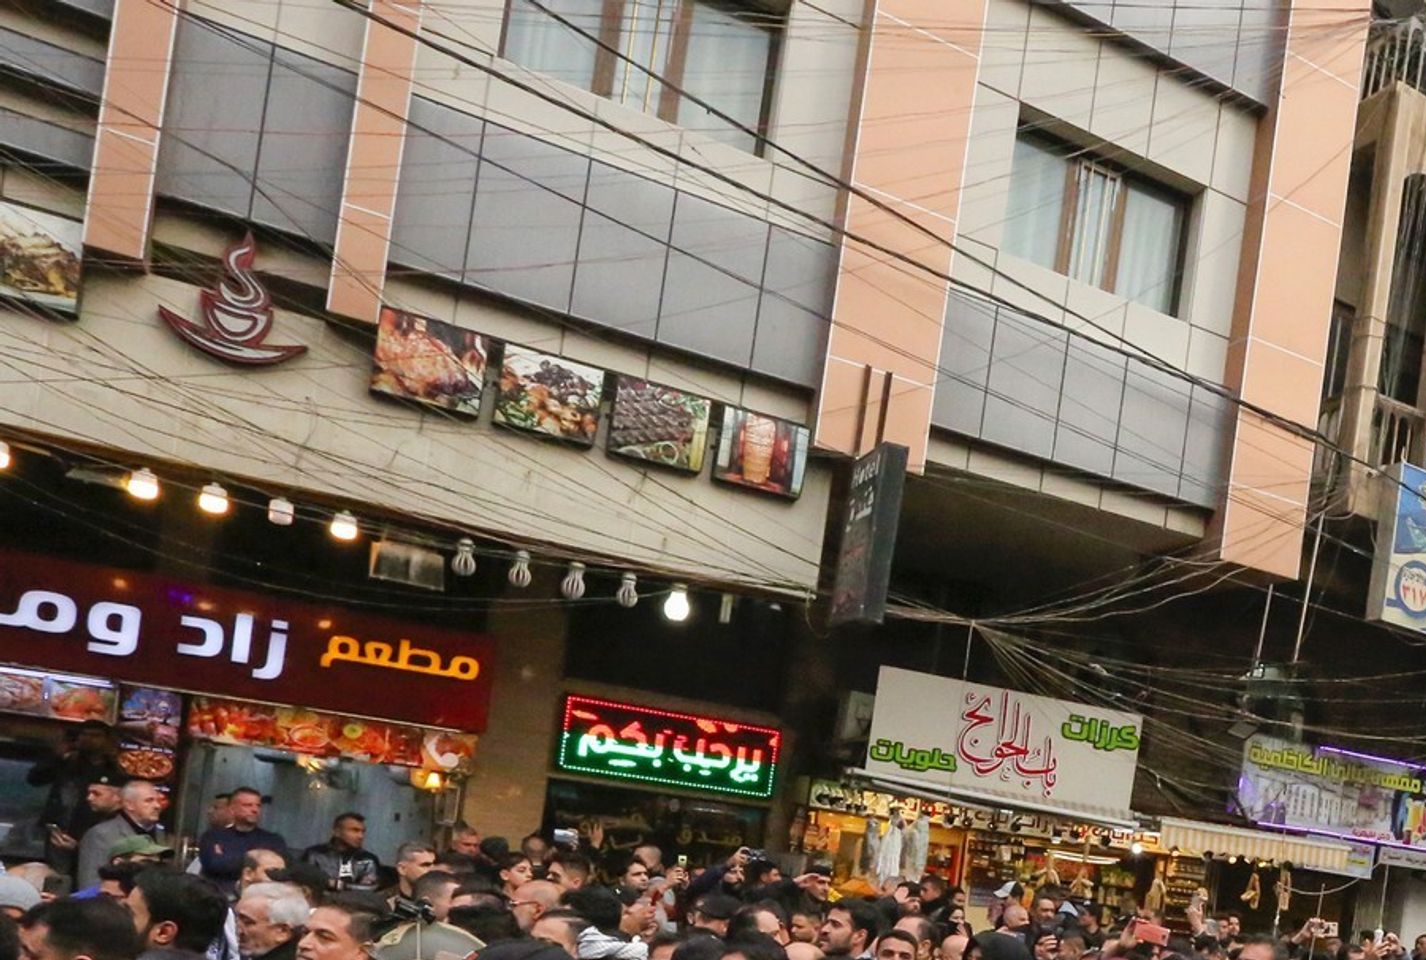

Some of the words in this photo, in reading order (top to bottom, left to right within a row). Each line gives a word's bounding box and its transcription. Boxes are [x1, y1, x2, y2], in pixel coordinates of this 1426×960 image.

[0, 589, 142, 657] وم
[176, 612, 290, 680] زاد
[319, 634, 480, 681] مطعم
[577, 720, 668, 768] بكم
[870, 737, 958, 773] حلويات
[1061, 713, 1140, 750] كرزات
[1250, 744, 1329, 780] الكاظمية
